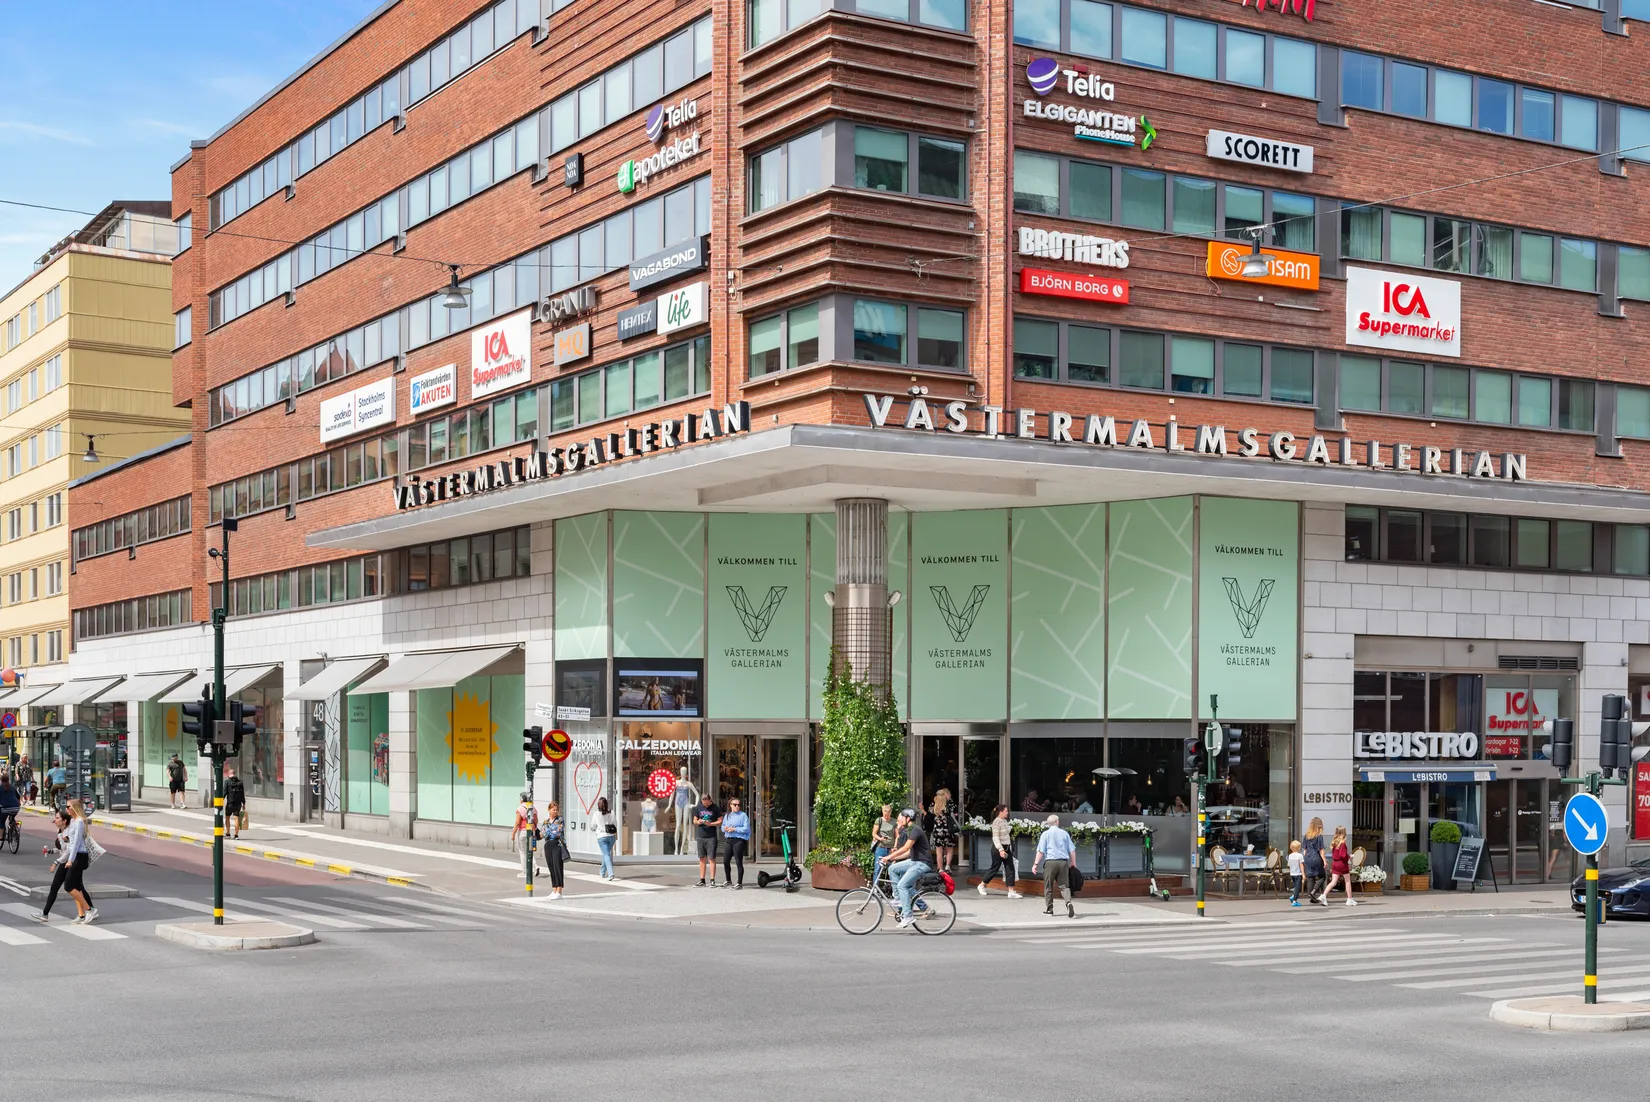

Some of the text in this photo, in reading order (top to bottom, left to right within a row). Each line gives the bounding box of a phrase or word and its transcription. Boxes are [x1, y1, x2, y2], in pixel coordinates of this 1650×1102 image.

[1062, 69, 1115, 101] Telia
[666, 98, 698, 129] Telia
[1023, 99, 1136, 133] ELGIGANTEN
[633, 130, 700, 184] apoteket
[1224, 135, 1302, 169] SCORETT
[1018, 226, 1130, 269] BROTHERS
[632, 247, 697, 281] VAGABOND
[1031, 275, 1109, 295] BJÖRN BORG
[540, 284, 600, 323] GRANIT
[1382, 280, 1431, 319] ICA
[1357, 311, 1456, 344] Supermarket
[484, 329, 510, 364] ICA
[558, 330, 585, 360] MQ
[420, 371, 452, 391] Folktandvården
[472, 354, 526, 386] Supermarket
[358, 391, 386, 409] Stockholms
[420, 383, 452, 407] AKUTEN
[358, 405, 384, 423] Syncentral
[863, 384, 1528, 482] VÄSTERMALMSGALLERIAN
[393, 400, 751, 511] VÄSTERMALMSGALLERIAN
[717, 555, 798, 566] VÄLKOMMEN TILL
[920, 554, 1000, 565] VÄLKOMMEN TILL
[1214, 544, 1284, 557] VÄLKOMMEN TILL
[724, 646, 789, 658] VÄSTERMALMS
[927, 646, 992, 658] VÄSTERMALMS
[1219, 643, 1277, 656] VÄSTERMALMS
[731, 659, 782, 669] GALLERIAN
[934, 659, 985, 669] GALLERIAN
[1225, 656, 1271, 667] GALLERIAN
[313, 702, 324, 722] 48
[1505, 691, 1540, 715] ICA
[615, 739, 702, 751] CALZEDONIA
[1354, 731, 1478, 758] LeBISTRO
[1412, 772, 1448, 781] LeBISTRO
[1638, 771, 1650, 782] SA
[1303, 790, 1353, 805] LeBISTRO
